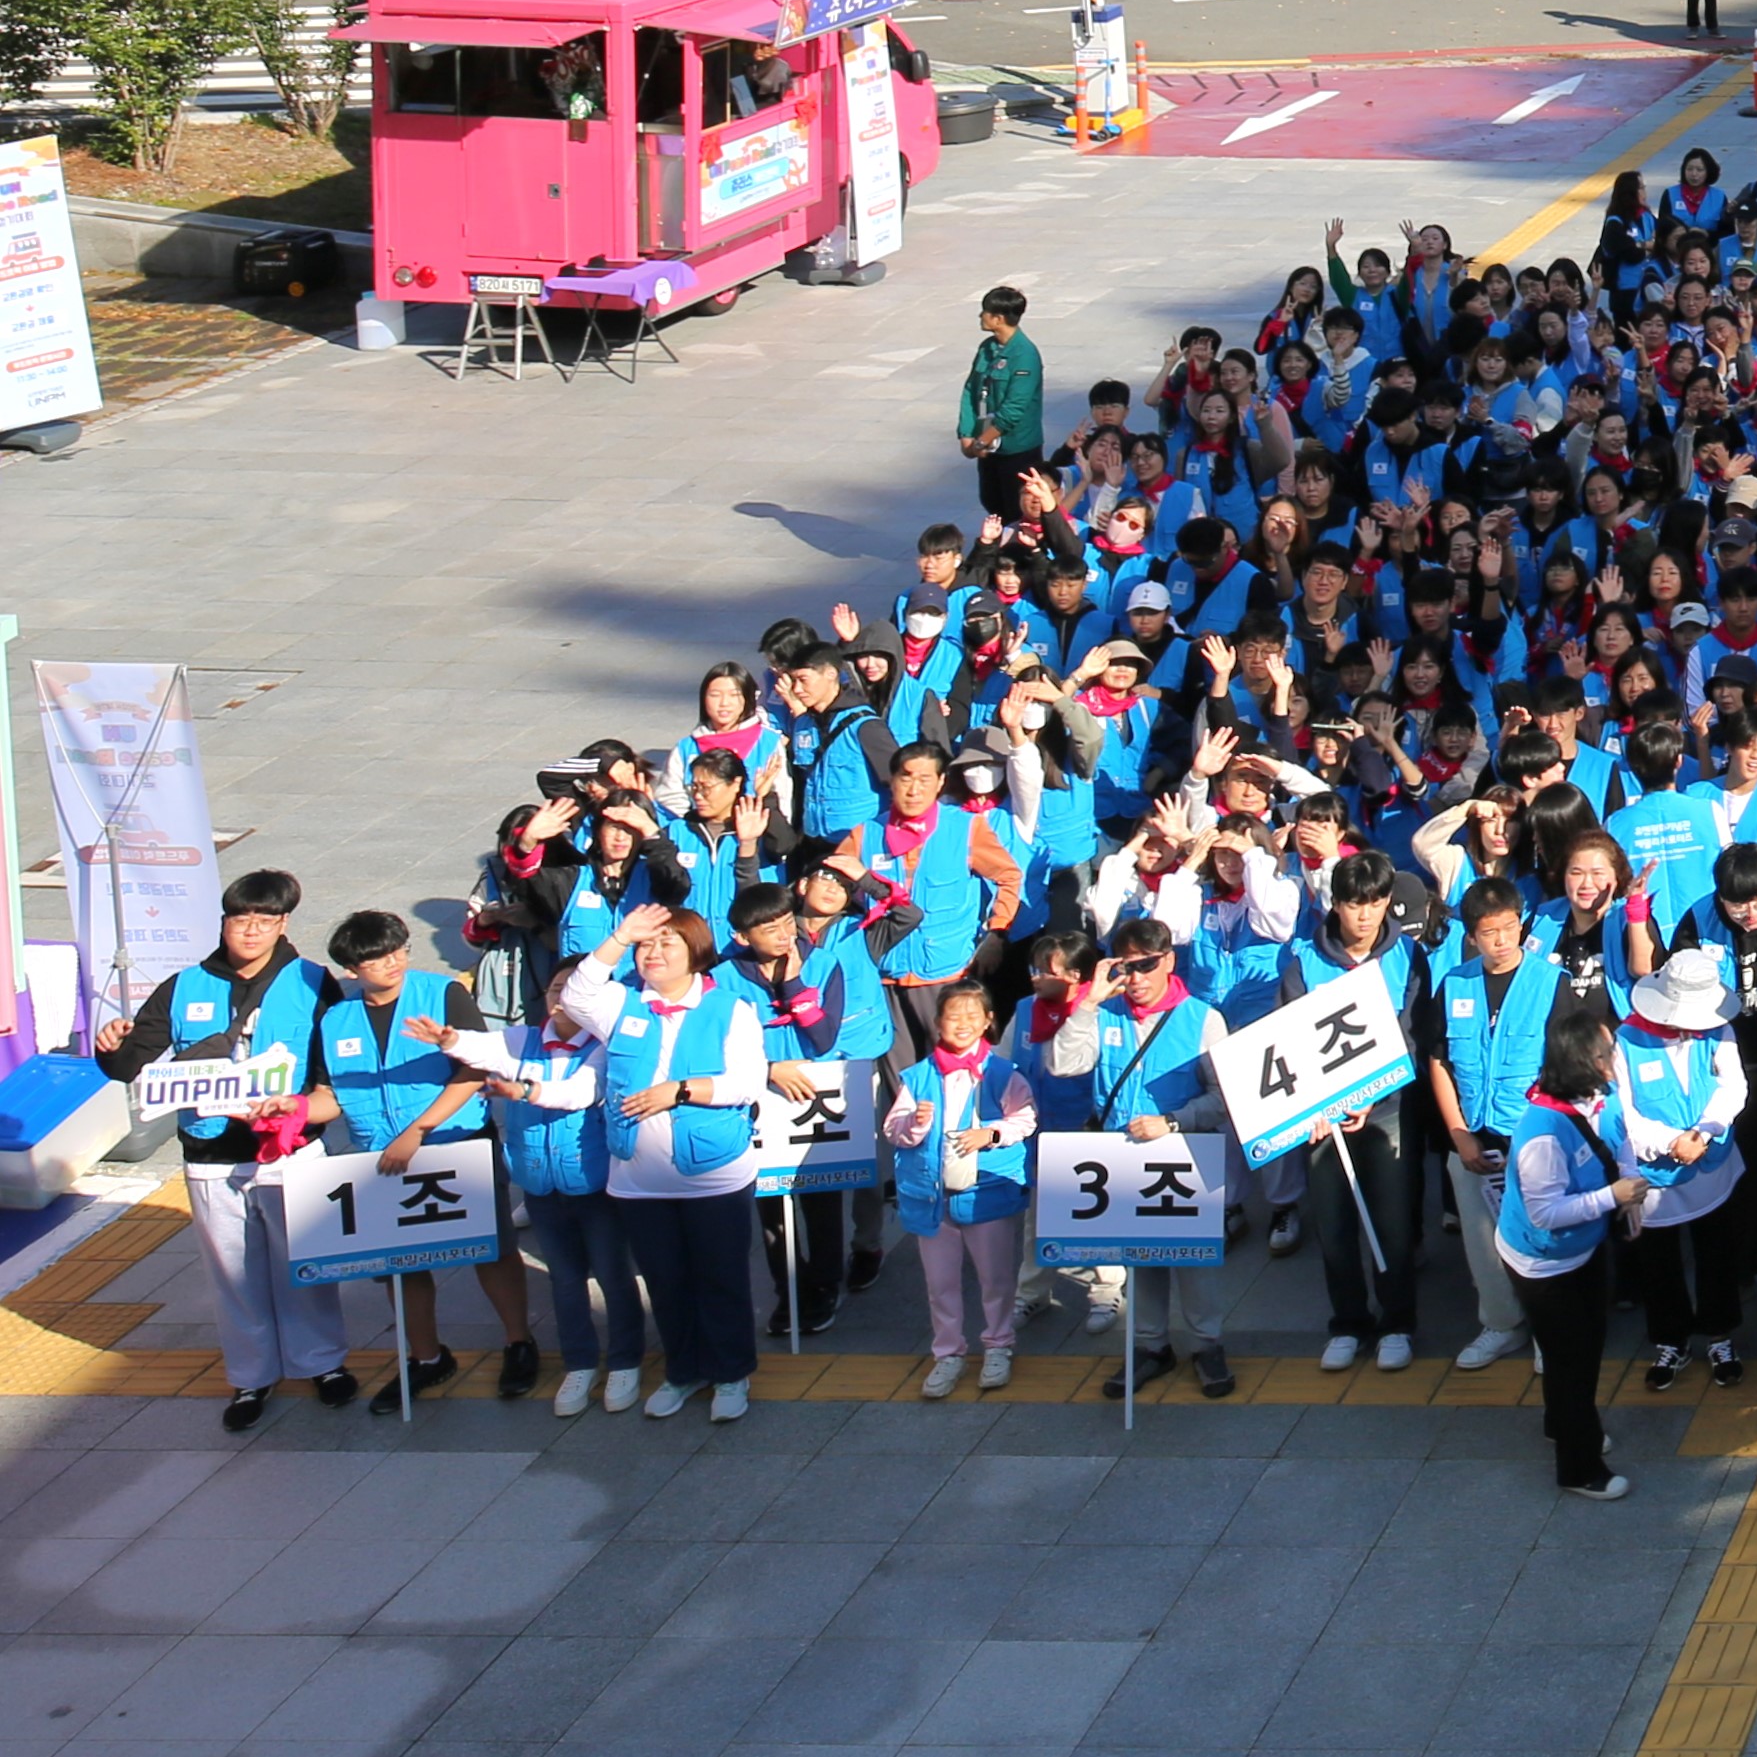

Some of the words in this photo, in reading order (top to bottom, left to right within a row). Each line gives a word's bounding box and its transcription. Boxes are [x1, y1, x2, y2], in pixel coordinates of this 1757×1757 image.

[1259, 1043, 1298, 1100] 4
[1314, 1001, 1377, 1075] 조
[789, 1088, 850, 1145] 조
[327, 1182, 356, 1236] 1
[398, 1170, 467, 1227] 조
[1071, 1161, 1110, 1220] 3
[1136, 1162, 1199, 1217] 조
[1125, 1246, 1218, 1262] 패밀리서포터즈
